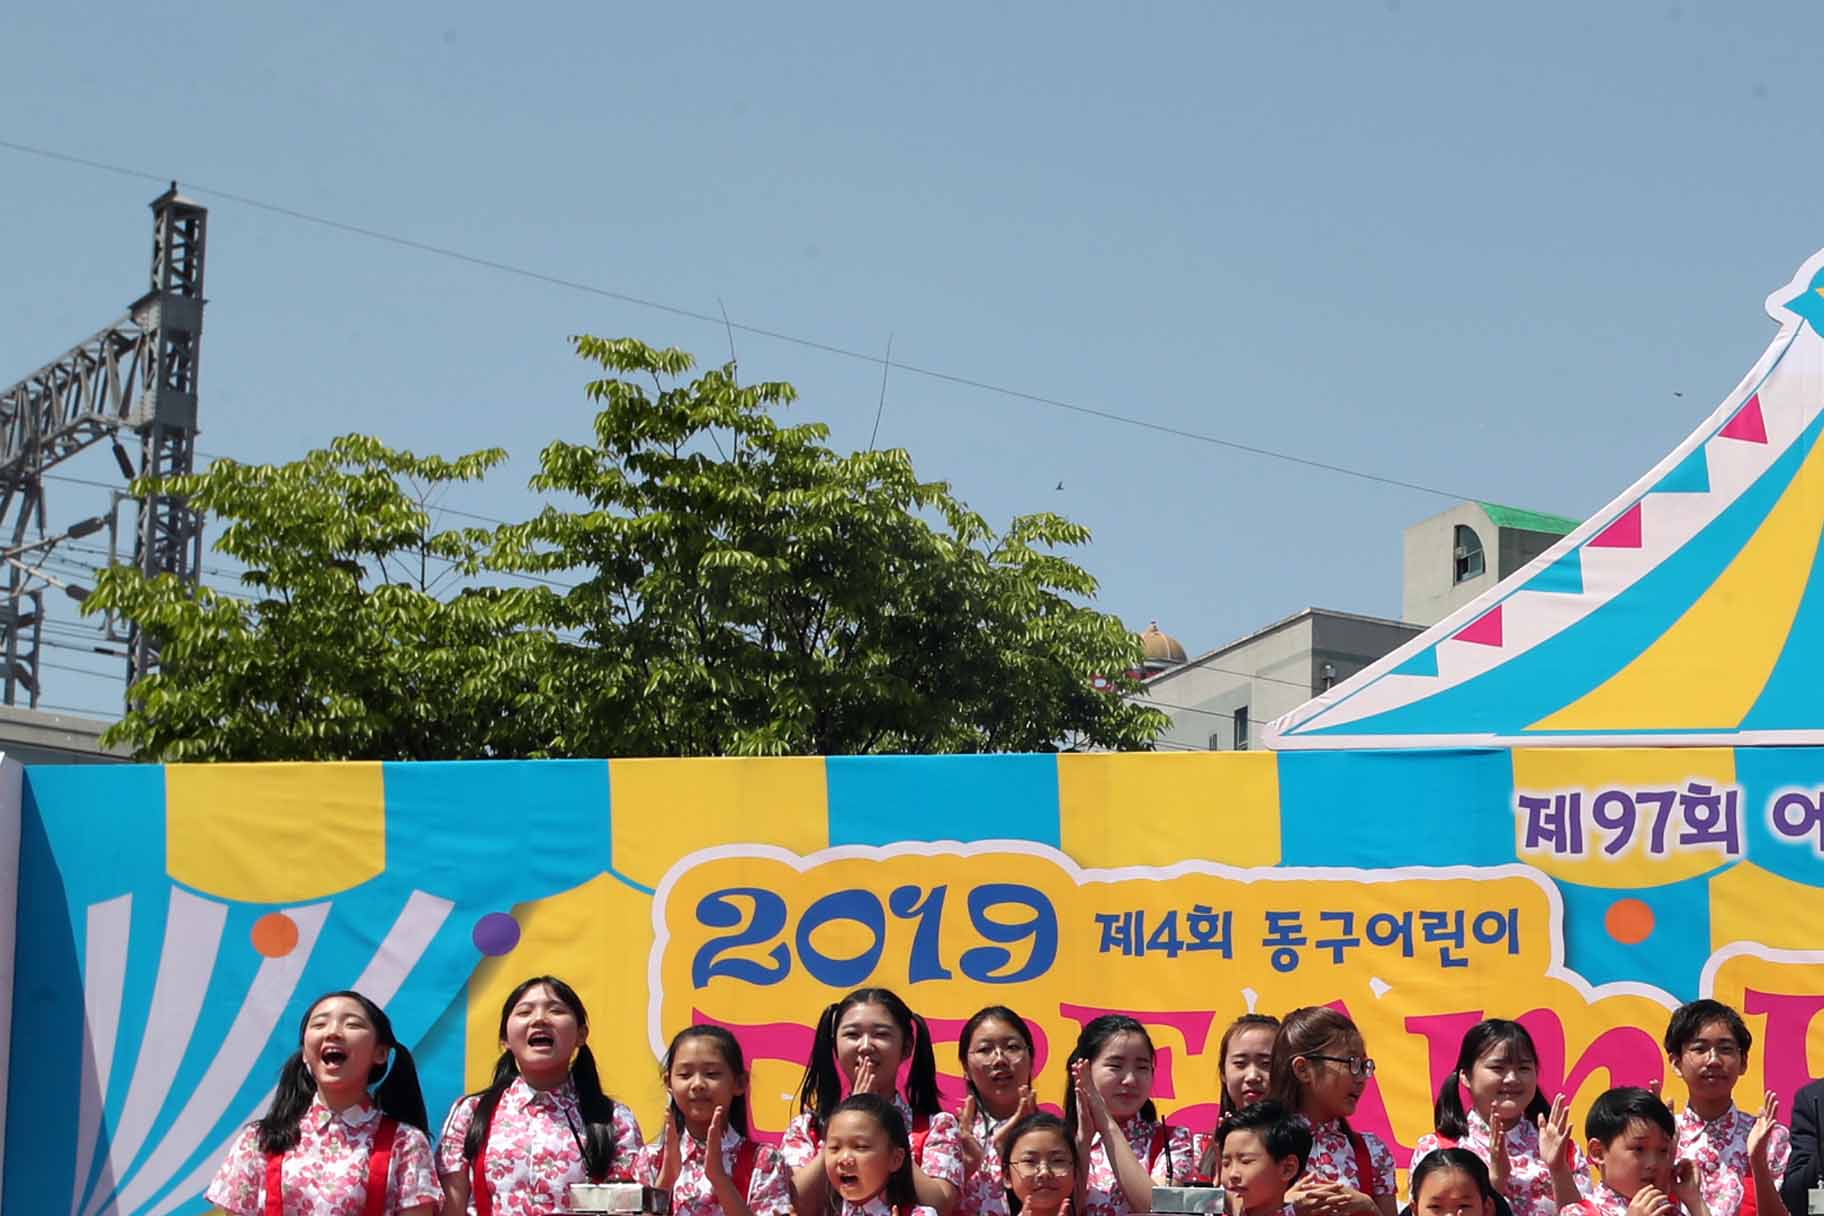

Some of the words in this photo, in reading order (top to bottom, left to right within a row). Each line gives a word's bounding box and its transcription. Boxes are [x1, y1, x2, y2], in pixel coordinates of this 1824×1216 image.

[1517, 782, 1741, 857] 제97회
[691, 882, 1058, 990] 2019
[1095, 904, 1233, 960] 제4회
[1263, 907, 1520, 974] 동구어린이
